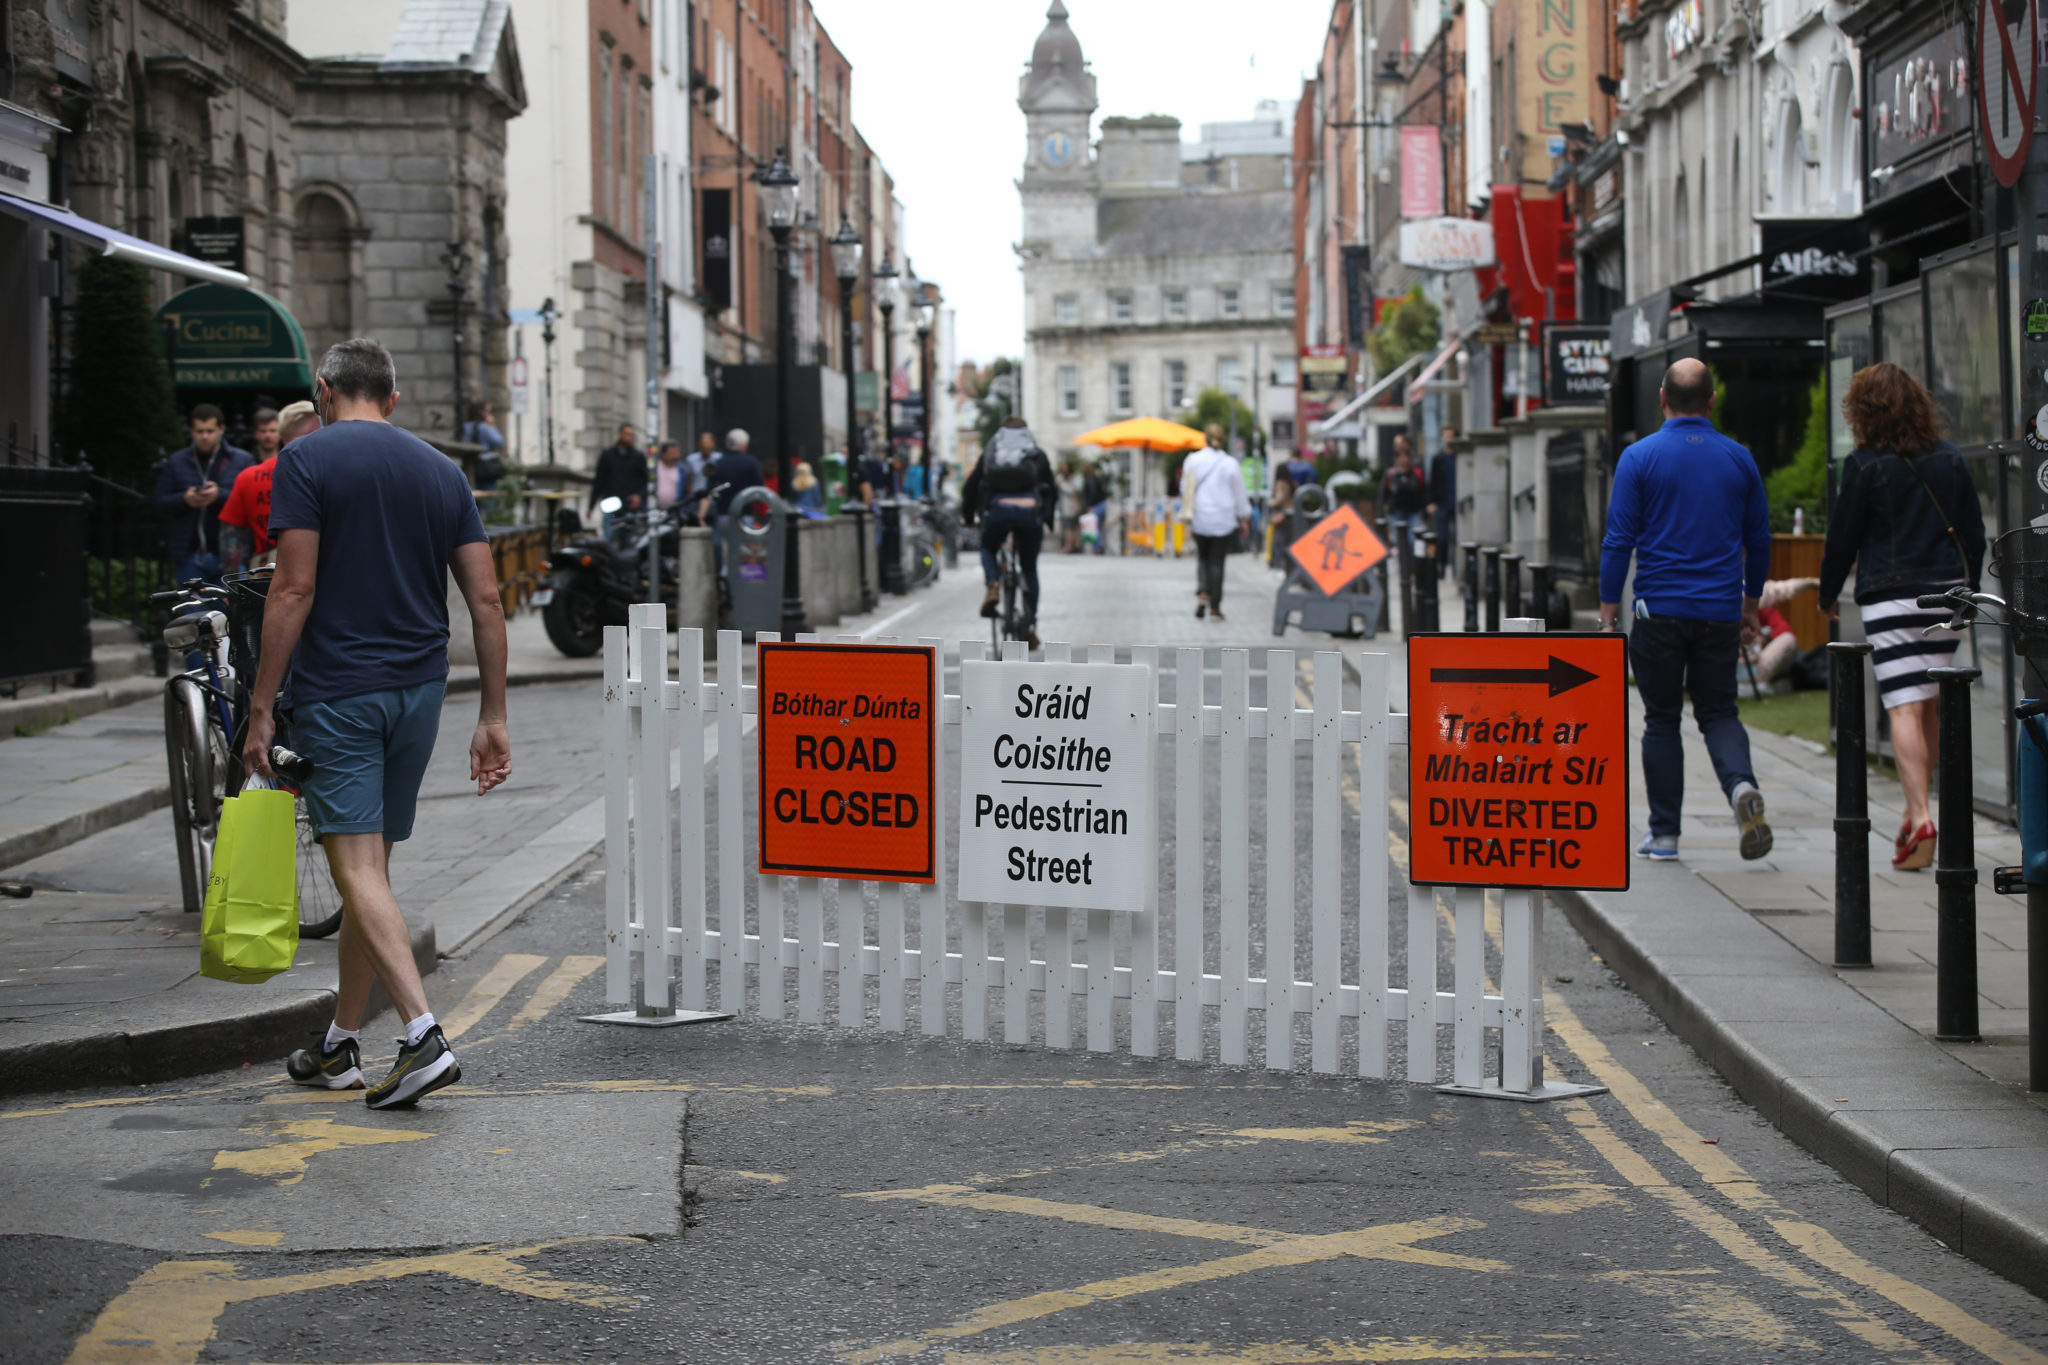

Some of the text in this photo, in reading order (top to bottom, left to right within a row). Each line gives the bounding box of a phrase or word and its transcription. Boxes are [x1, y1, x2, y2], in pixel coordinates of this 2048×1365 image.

[772, 692, 920, 719] Bóthar Dúnta
[1015, 684, 1091, 720] Sráid
[1444, 714, 1588, 745] Trácht ar
[796, 735, 897, 772] ROAD
[994, 734, 1111, 772] Coisithe
[1425, 754, 1609, 785] Mhalairt Slí
[774, 788, 918, 828] CLOSED
[975, 794, 1128, 834] Pedestrian
[1430, 798, 1597, 830] DIVERTED
[1007, 847, 1092, 885] Street
[1443, 836, 1581, 869] TRAFFIC
